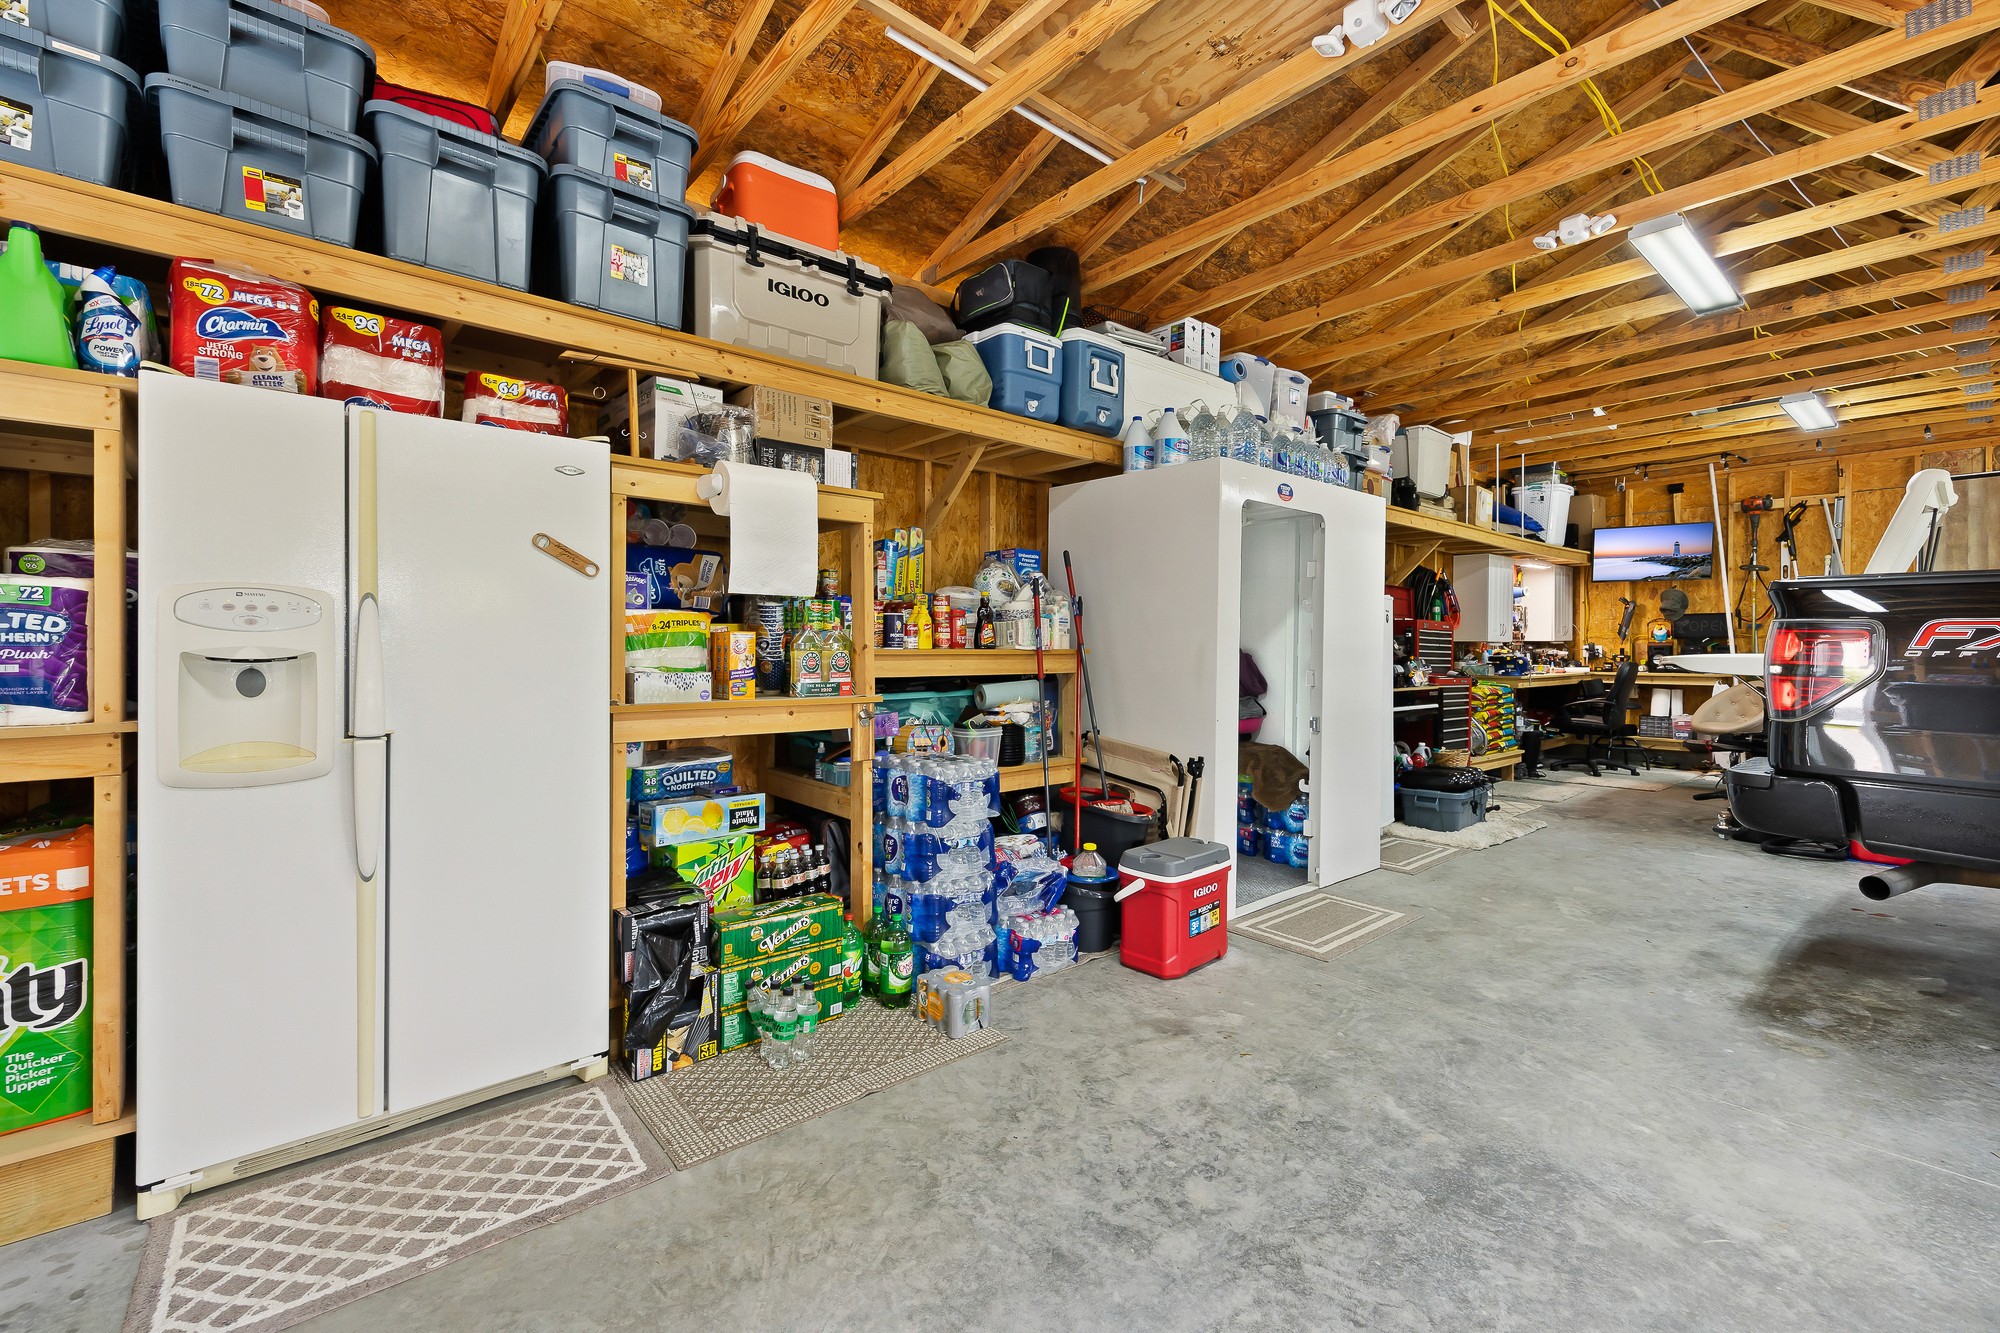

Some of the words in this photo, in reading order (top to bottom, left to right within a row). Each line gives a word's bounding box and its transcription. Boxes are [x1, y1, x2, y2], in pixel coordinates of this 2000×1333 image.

[200, 283, 225, 300] 72
[232, 290, 274, 308] MEGA
[768, 277, 830, 308] IGLOO
[85, 317, 123, 334] Lysol
[206, 315, 269, 334] Charmin
[354, 315, 379, 333] 96
[94, 345, 124, 354] POWER
[206, 341, 235, 351] ULTRA
[392, 336, 432, 352] MEGA
[198, 347, 244, 360] STRONG
[498, 383, 519, 396] 64
[525, 388, 558, 401] MEGA
[659, 559, 667, 576] Soft
[20, 586, 44, 599] 72
[672, 619, 701, 627] TRIPLES
[802, 652, 820, 666] MURPHY
[831, 652, 850, 665] MURPHY
[644, 778, 657, 786] 48
[662, 770, 717, 787] QUILTED
[731, 815, 758, 825] Minute
[734, 809, 755, 818] Maid
[1193, 883, 1218, 899] IGLOO
[1198, 903, 1213, 914] IGLOO
[759, 914, 811, 953] Vernors
[691, 948, 700, 962] 40
[5, 1051, 35, 1063] The
[700, 1046, 709, 1058] 24
[5, 1053, 66, 1074] Quicker
[5, 1066, 55, 1085] Picker
[5, 1076, 54, 1094] Upper
